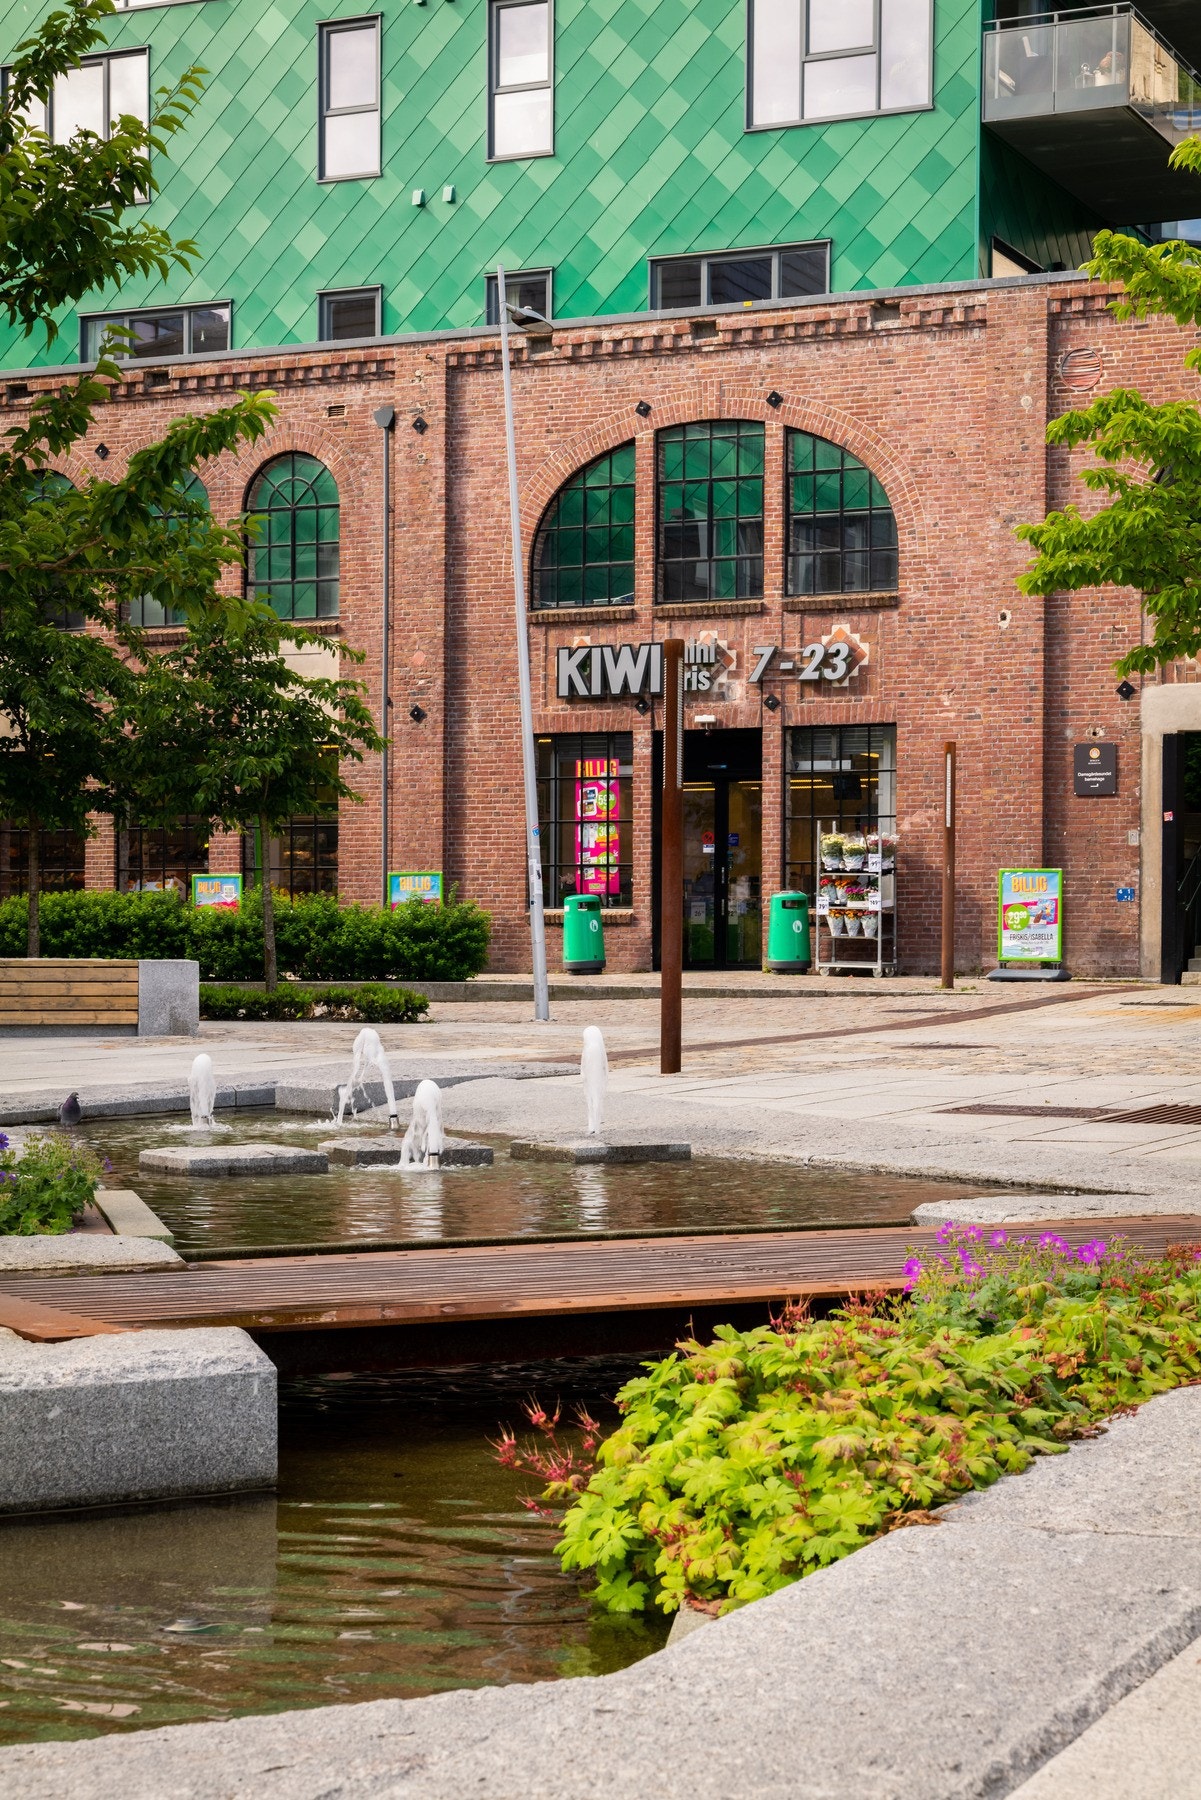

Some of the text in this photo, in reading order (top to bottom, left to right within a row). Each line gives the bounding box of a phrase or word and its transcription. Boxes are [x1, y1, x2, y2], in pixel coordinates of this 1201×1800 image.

[557, 642, 664, 697] KIWI
[197, 881, 222, 894] BILLIG
[400, 876, 431, 891] BILLIG
[1011, 876, 1048, 893] BILLIG
